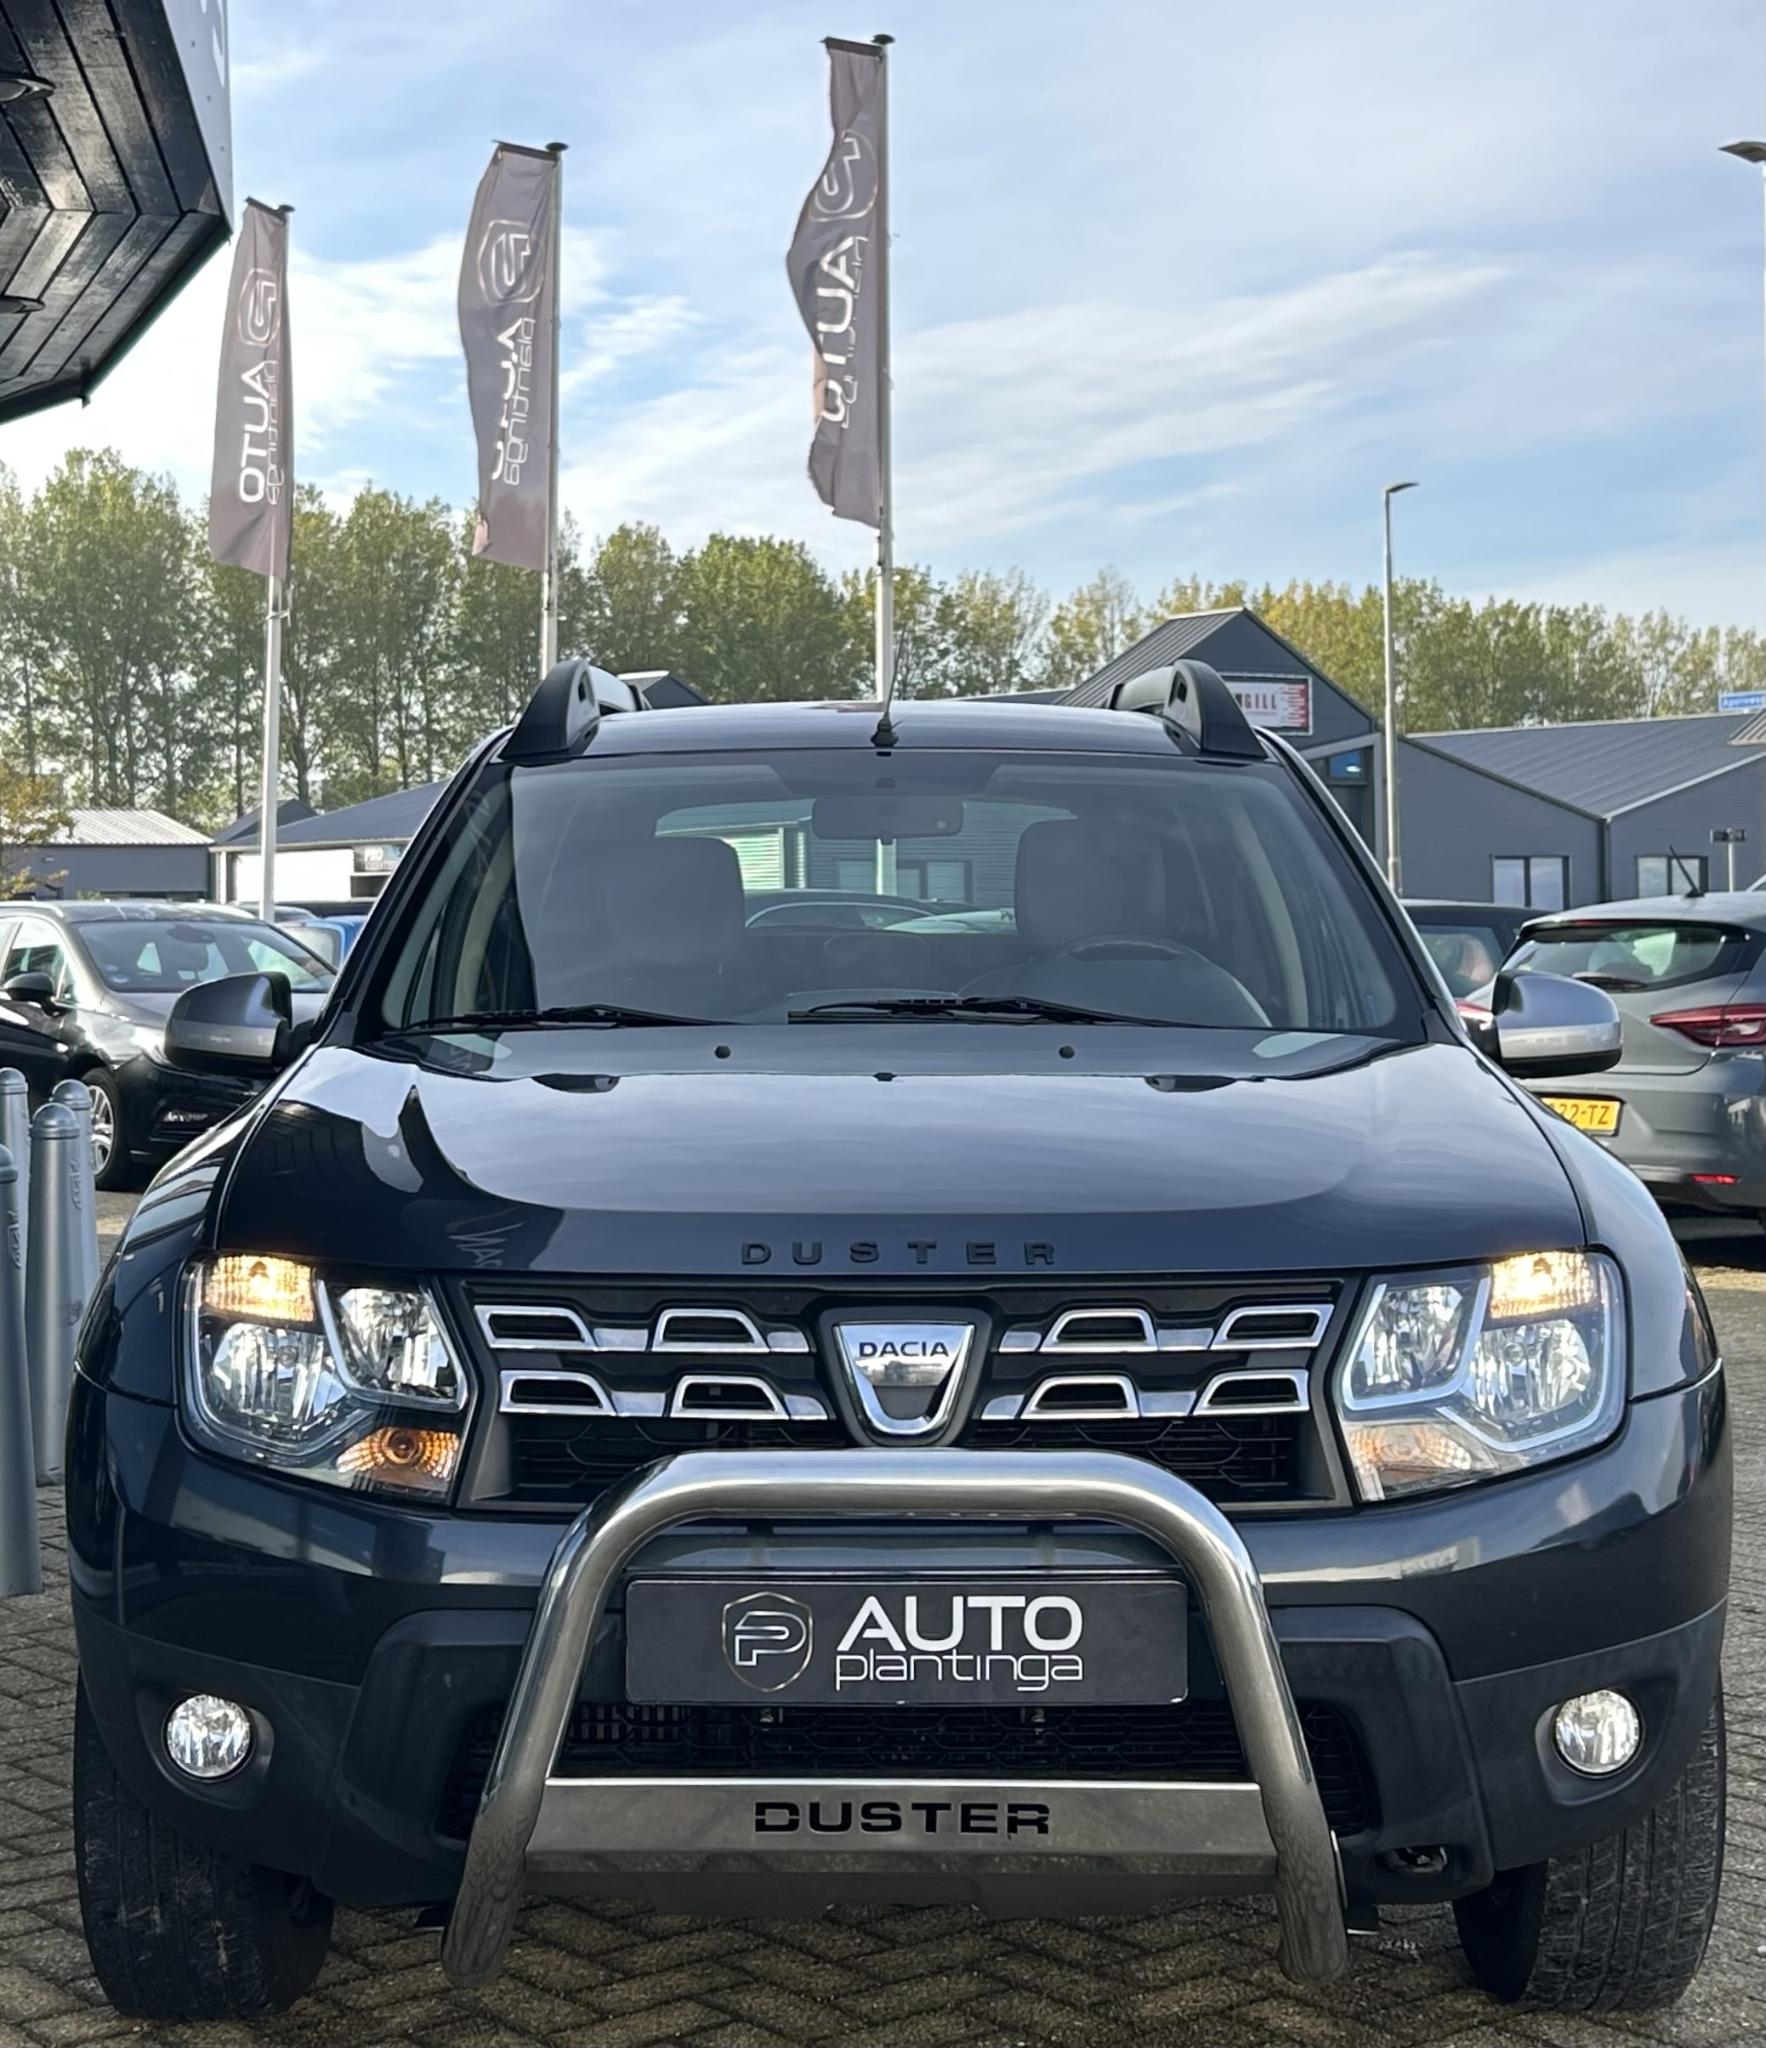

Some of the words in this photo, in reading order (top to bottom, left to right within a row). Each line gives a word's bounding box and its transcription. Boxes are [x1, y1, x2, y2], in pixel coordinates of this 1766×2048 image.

[741, 1242, 1056, 1266] DUSTER
[858, 1341, 950, 1358] DACIA
[836, 1595, 1084, 1652] AUTO
[835, 1649, 1084, 1692] plantinga
[754, 1801, 1051, 1840] DUSTER
